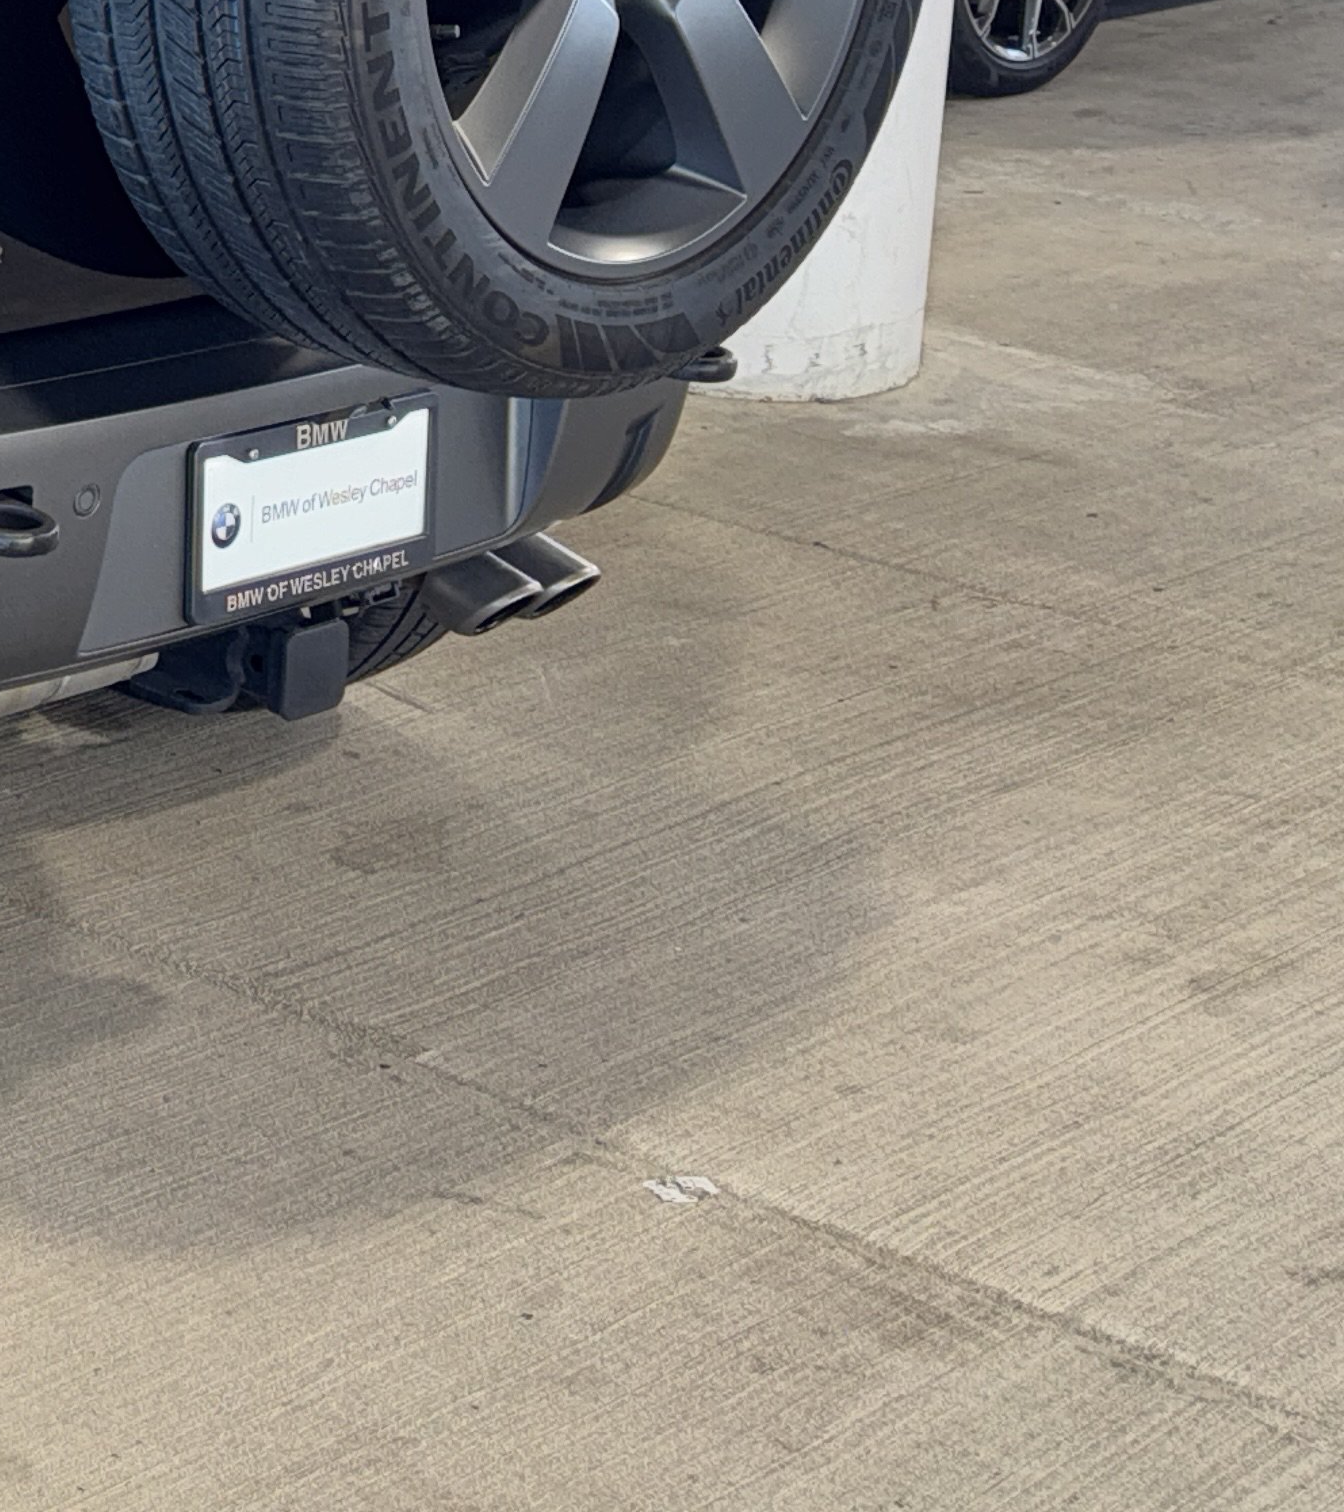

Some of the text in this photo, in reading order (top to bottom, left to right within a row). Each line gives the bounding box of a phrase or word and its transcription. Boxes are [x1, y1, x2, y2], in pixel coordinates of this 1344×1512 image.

[296, 419, 348, 449] BMW
[262, 470, 418, 524] BMW of Wesley Chapel
[226, 549, 409, 612] BMW OF WESLEY CHAPEL
